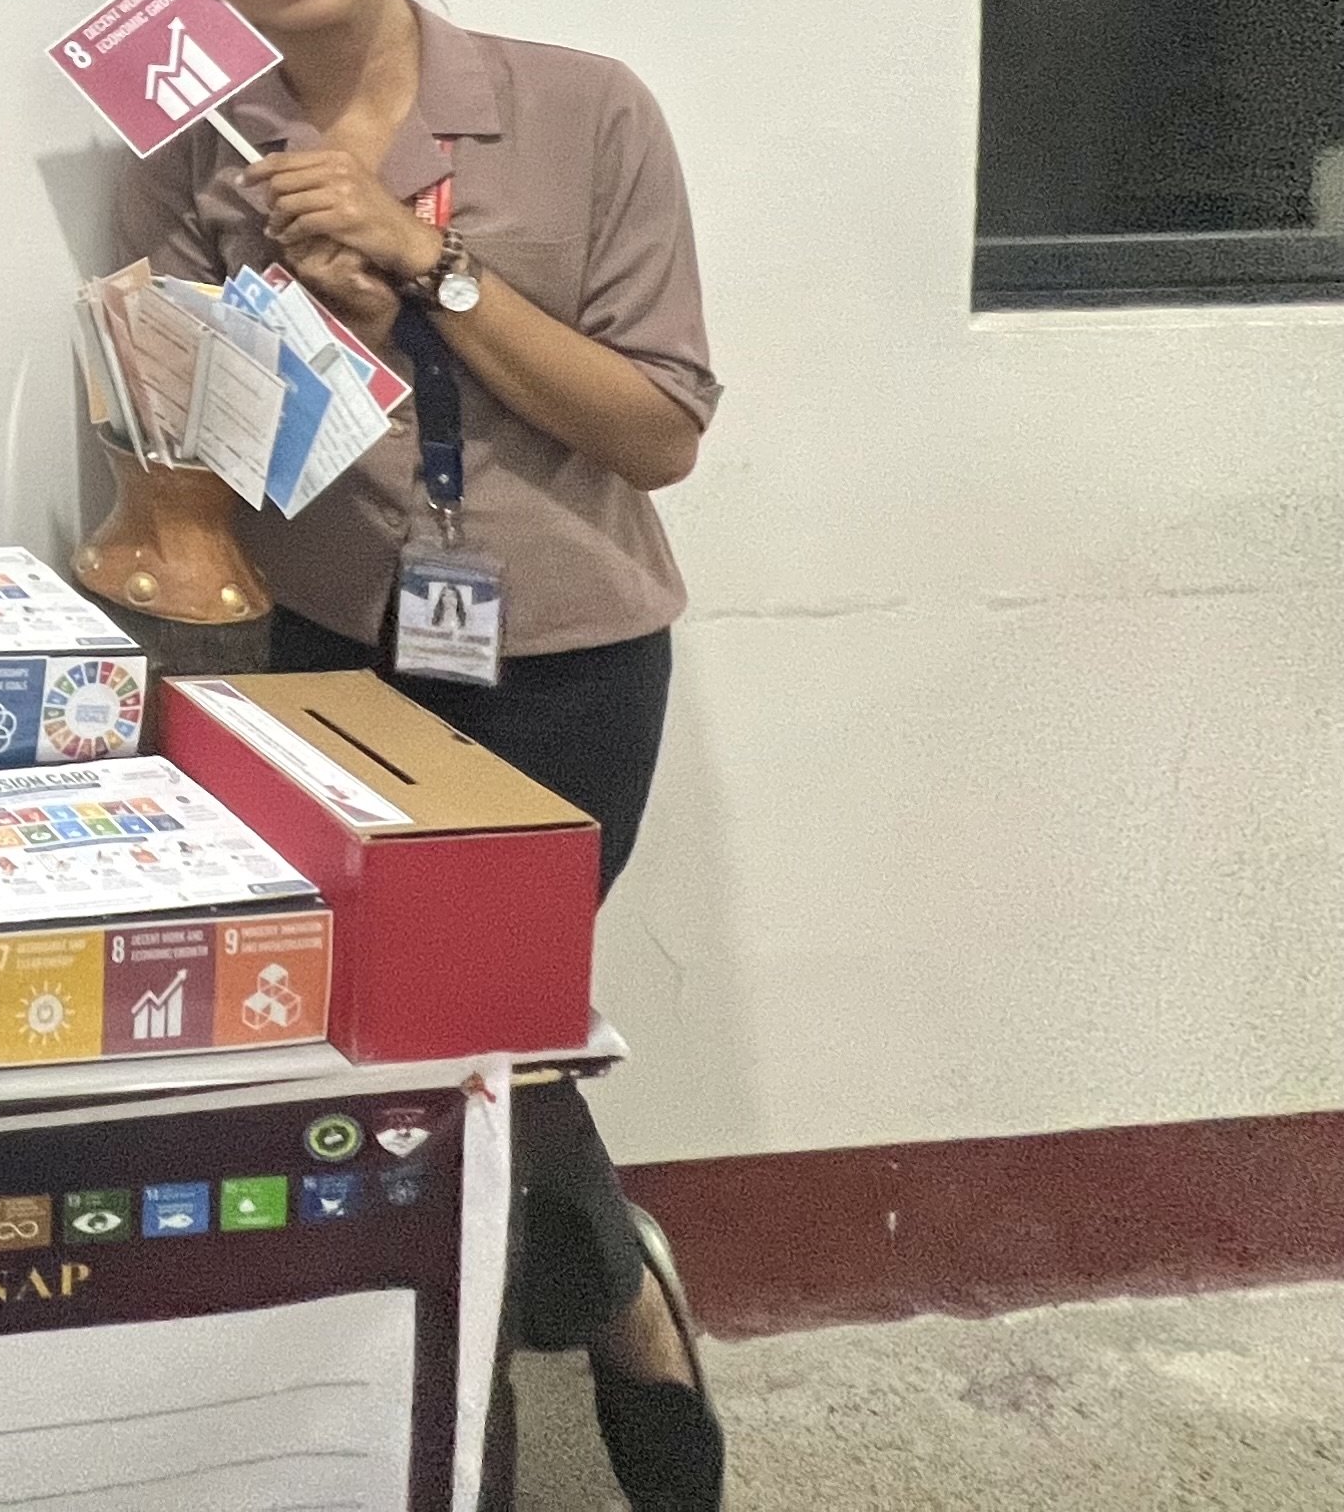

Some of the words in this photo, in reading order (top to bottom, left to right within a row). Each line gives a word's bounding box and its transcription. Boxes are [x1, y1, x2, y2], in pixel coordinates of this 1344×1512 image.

[64, 41, 92, 68] 8
[46, 770, 99, 786] CARD
[112, 935, 125, 963] 8
[224, 929, 238, 955] 9
